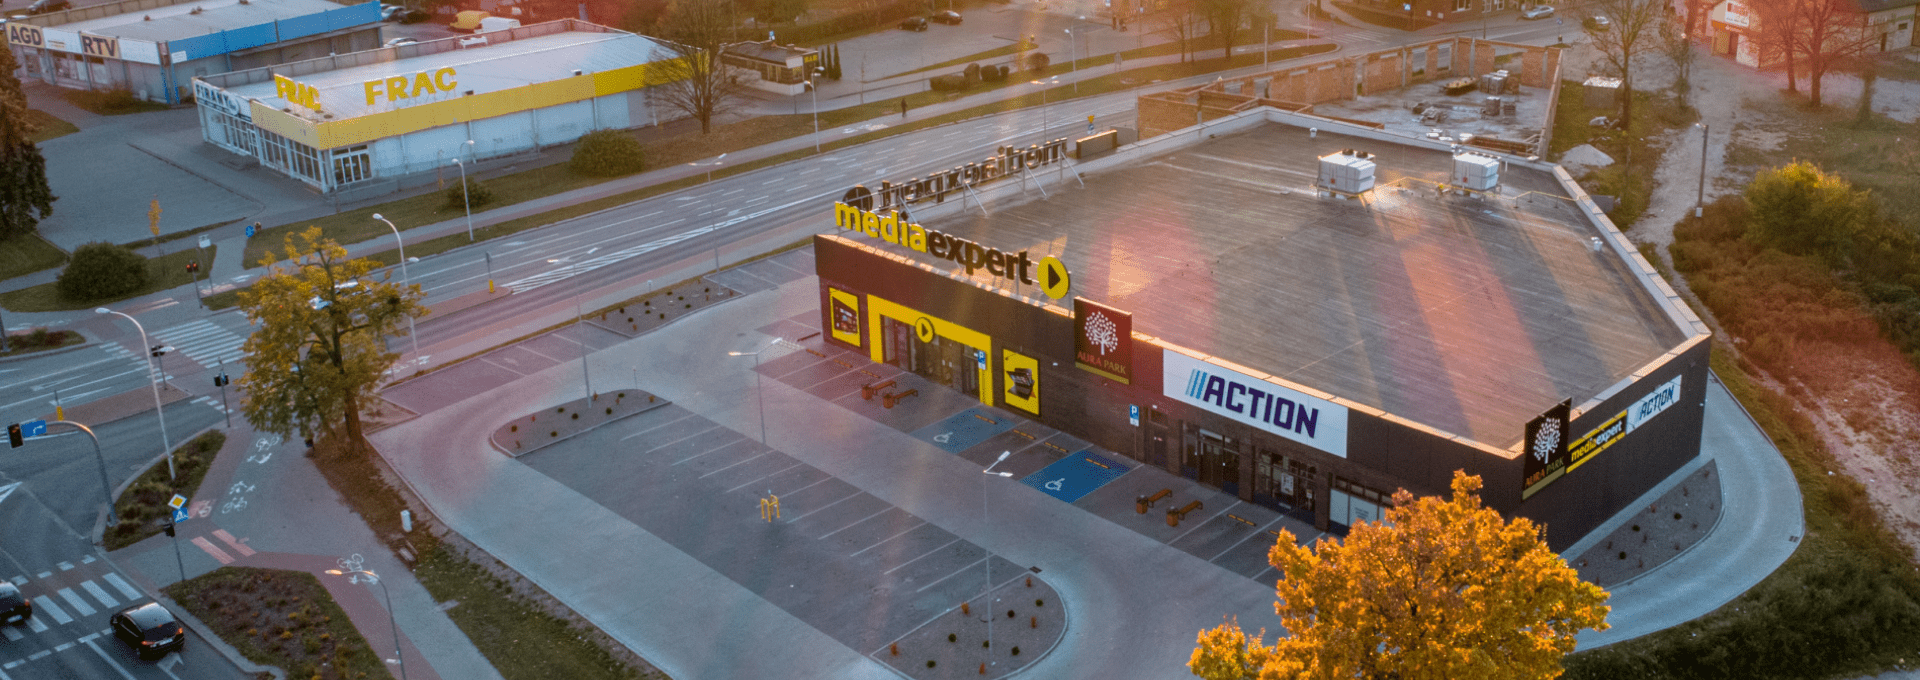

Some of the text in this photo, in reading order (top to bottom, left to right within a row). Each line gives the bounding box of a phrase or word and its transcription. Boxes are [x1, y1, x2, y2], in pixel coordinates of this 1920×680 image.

[10, 25, 42, 46] AGD
[82, 35, 116, 57] RTV
[274, 74, 321, 110] FRAC
[364, 67, 458, 105] FRAC
[835, 201, 1032, 285] mediaexpert
[1077, 351, 1126, 375] AURA PARK
[1203, 375, 1319, 439] ACTION
[1639, 384, 1675, 420] ACTION
[1571, 421, 1622, 462] mediaexpert
[1526, 457, 1564, 486] AURA PARK
